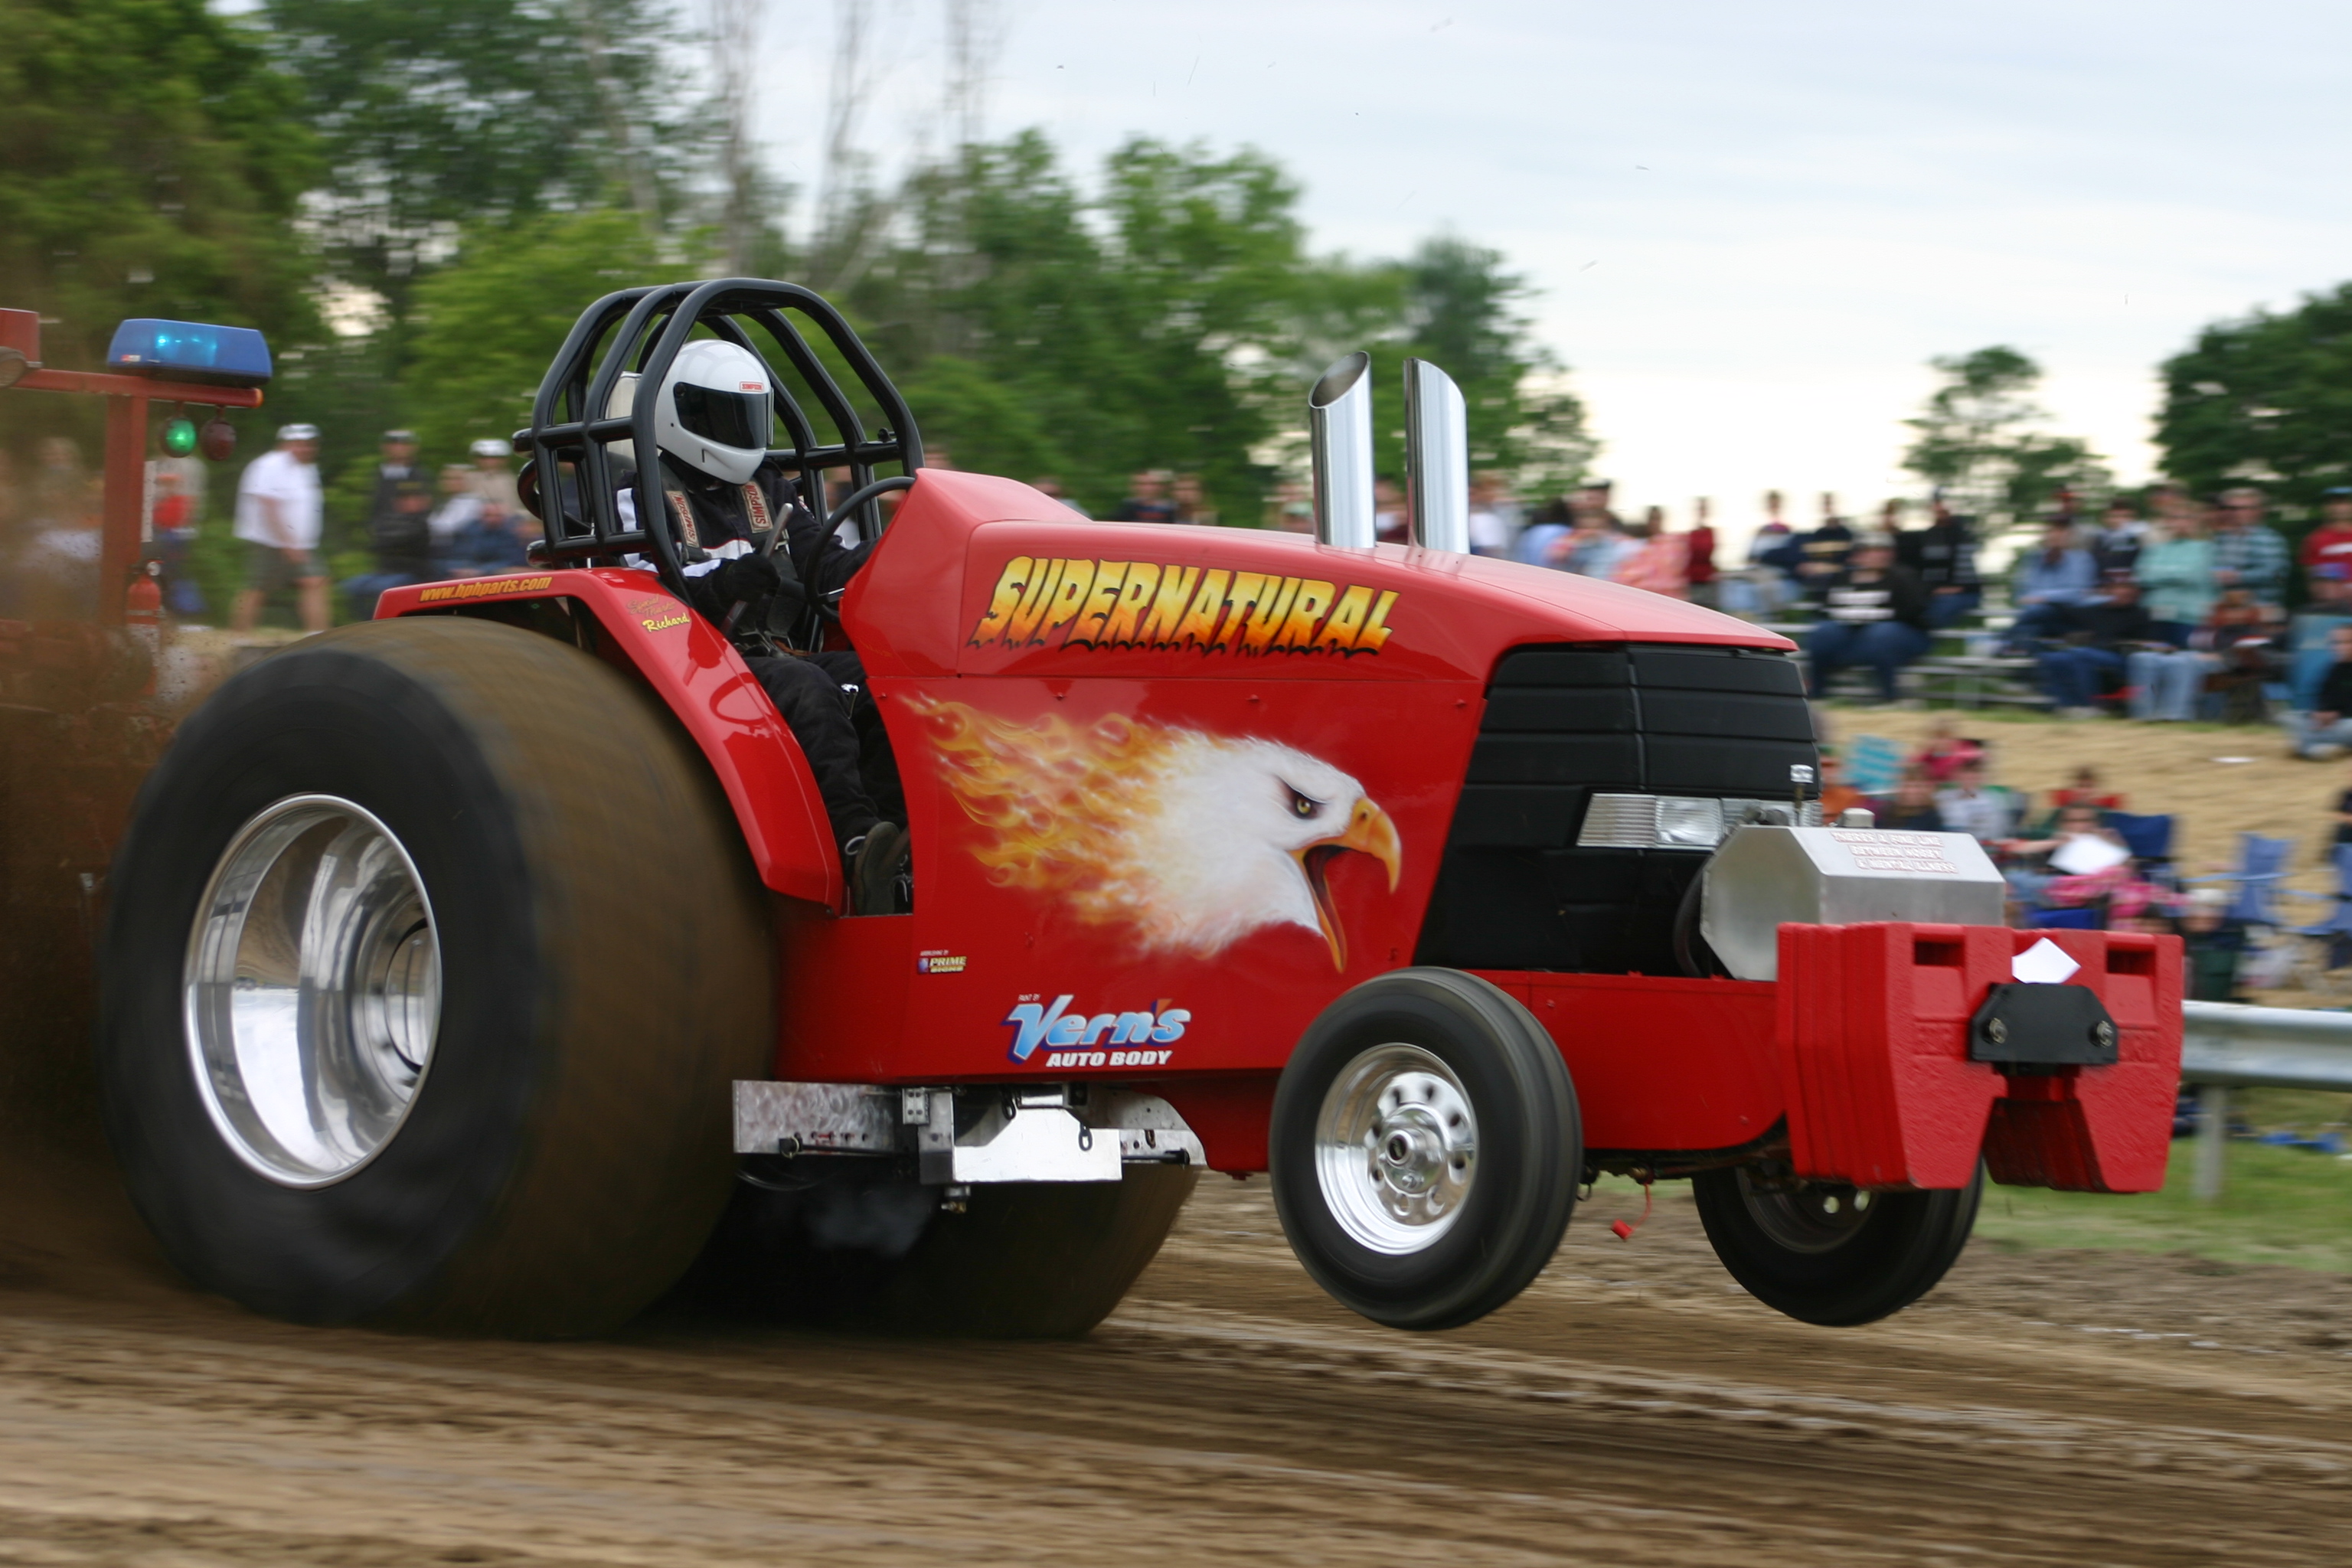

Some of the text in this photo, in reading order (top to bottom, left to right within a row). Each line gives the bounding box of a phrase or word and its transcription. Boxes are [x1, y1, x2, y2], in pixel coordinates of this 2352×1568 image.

[676, 496, 696, 541] SIMPSON
[744, 484, 766, 525] SIMPSON
[419, 577, 553, 603] www.hphparts.com
[965, 555, 1400, 658] SUPERNATURAL
[642, 612, 691, 632] Richard
[929, 956, 967, 967] PRIME
[1002, 995, 1191, 1063] Vern's
[1046, 1050, 1173, 1067] AUTO BODY
